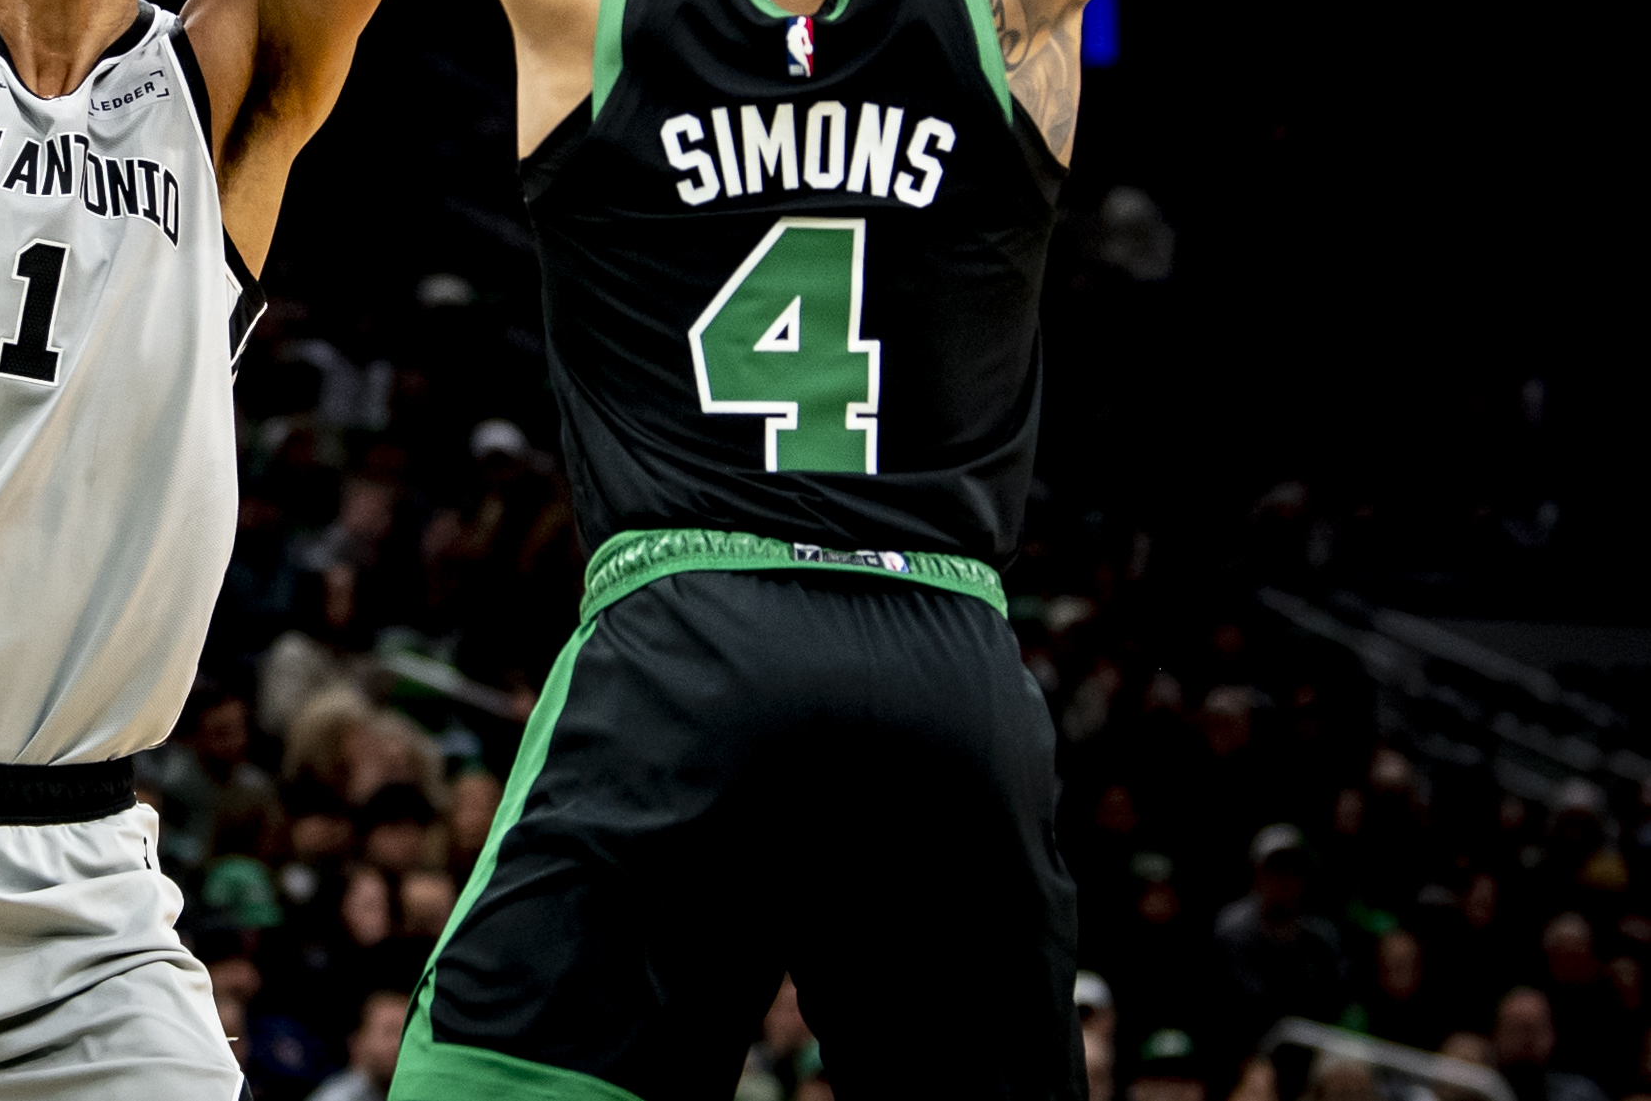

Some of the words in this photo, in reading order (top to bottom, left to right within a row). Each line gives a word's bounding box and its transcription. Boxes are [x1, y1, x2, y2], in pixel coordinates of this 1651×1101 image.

[91, 80, 155, 111] LEDGER
[660, 100, 956, 208] SIMONS
[688, 218, 881, 475] 4
